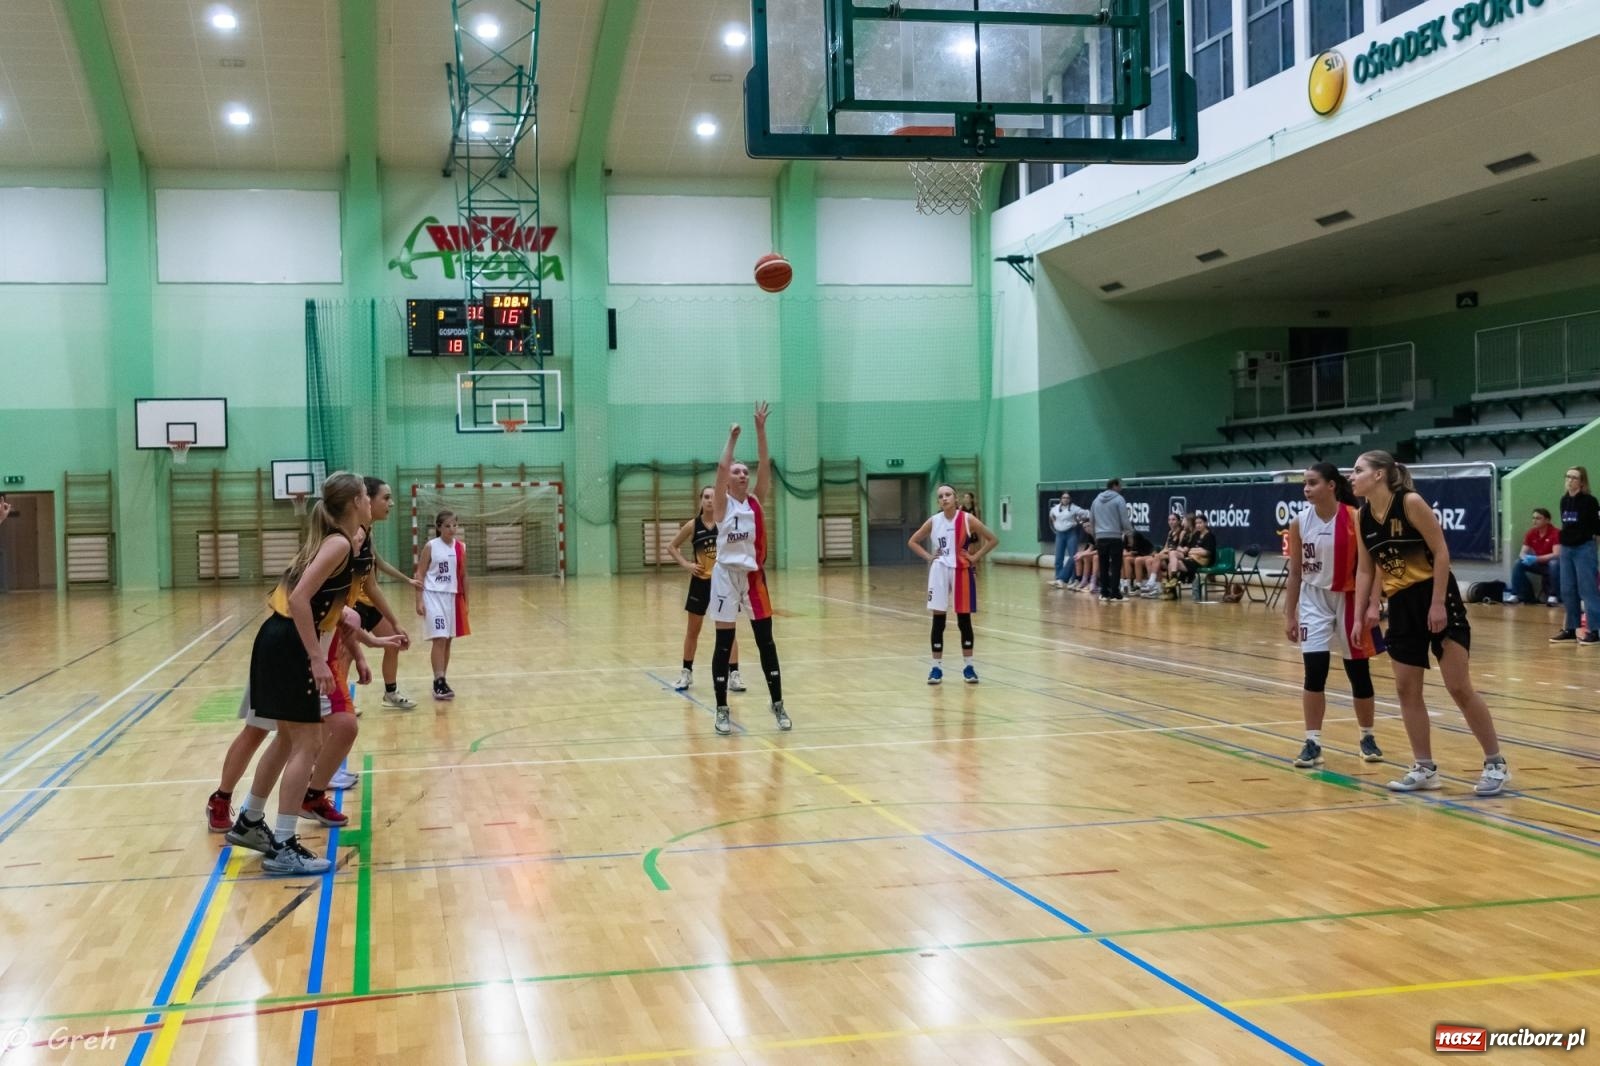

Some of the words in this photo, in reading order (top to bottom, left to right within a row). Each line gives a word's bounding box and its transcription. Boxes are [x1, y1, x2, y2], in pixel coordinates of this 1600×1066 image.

[1353, 15, 1447, 84] OŚRODEK
[1452, 0, 1545, 41] SPOR
[502, 310, 518, 324] 16
[448, 340, 462, 352] 18
[1303, 542, 1316, 559] 30
